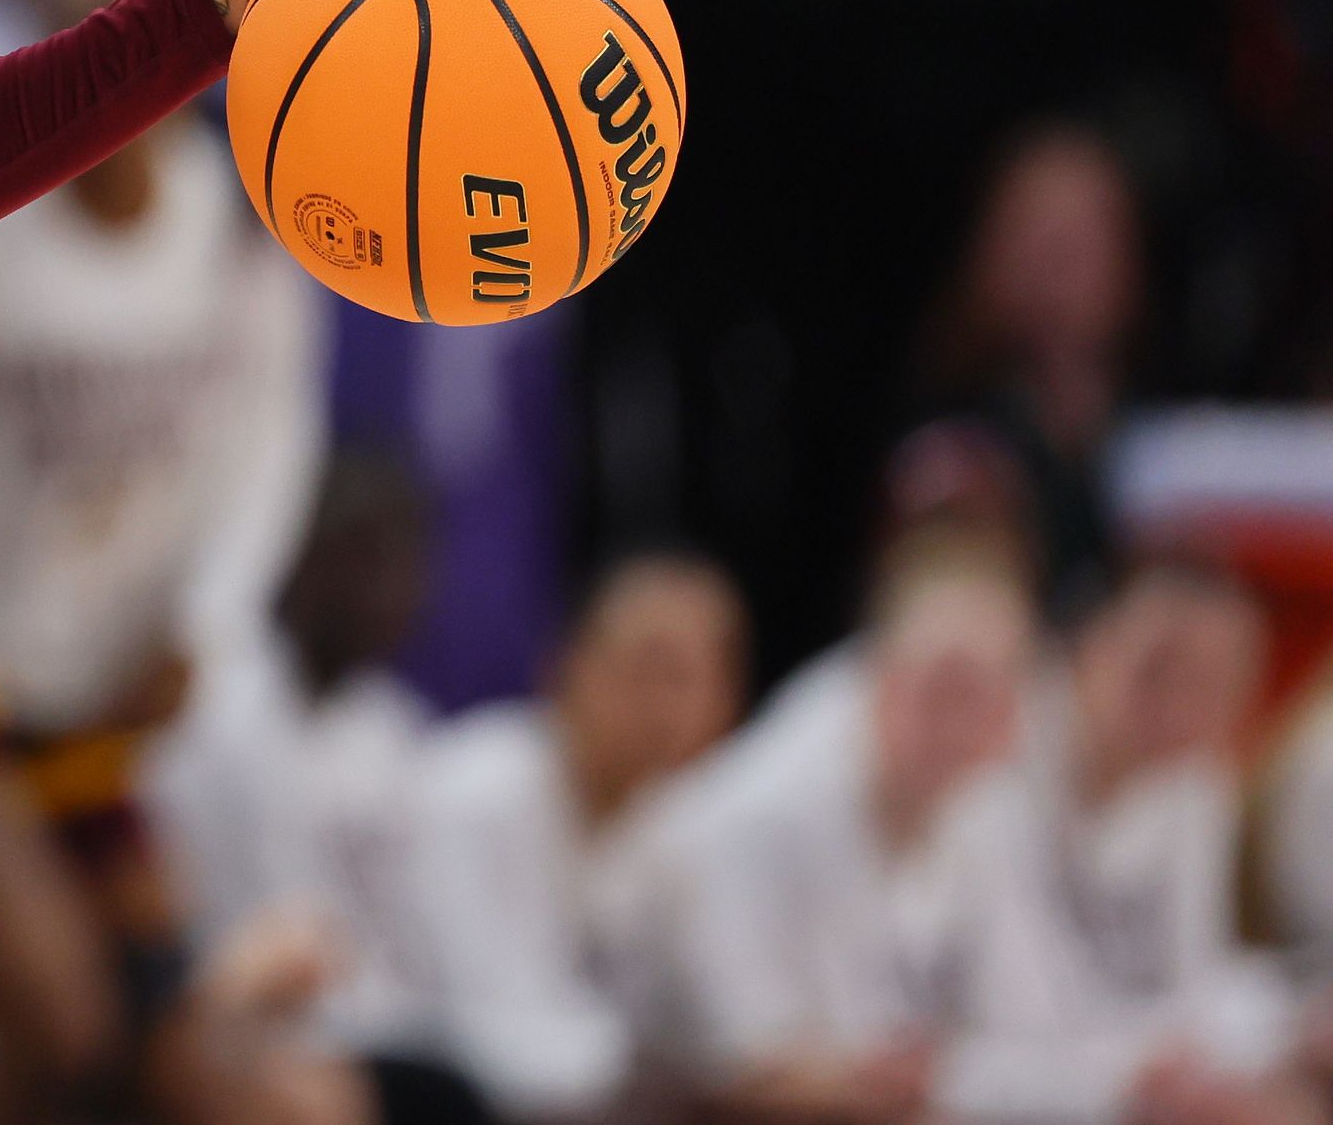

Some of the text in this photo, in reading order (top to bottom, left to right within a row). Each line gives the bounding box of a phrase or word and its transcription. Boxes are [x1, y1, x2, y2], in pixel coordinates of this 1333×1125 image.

[578, 29, 667, 262] Wilso
[598, 160, 616, 208] INDOOR
[461, 173, 533, 304] EVO
